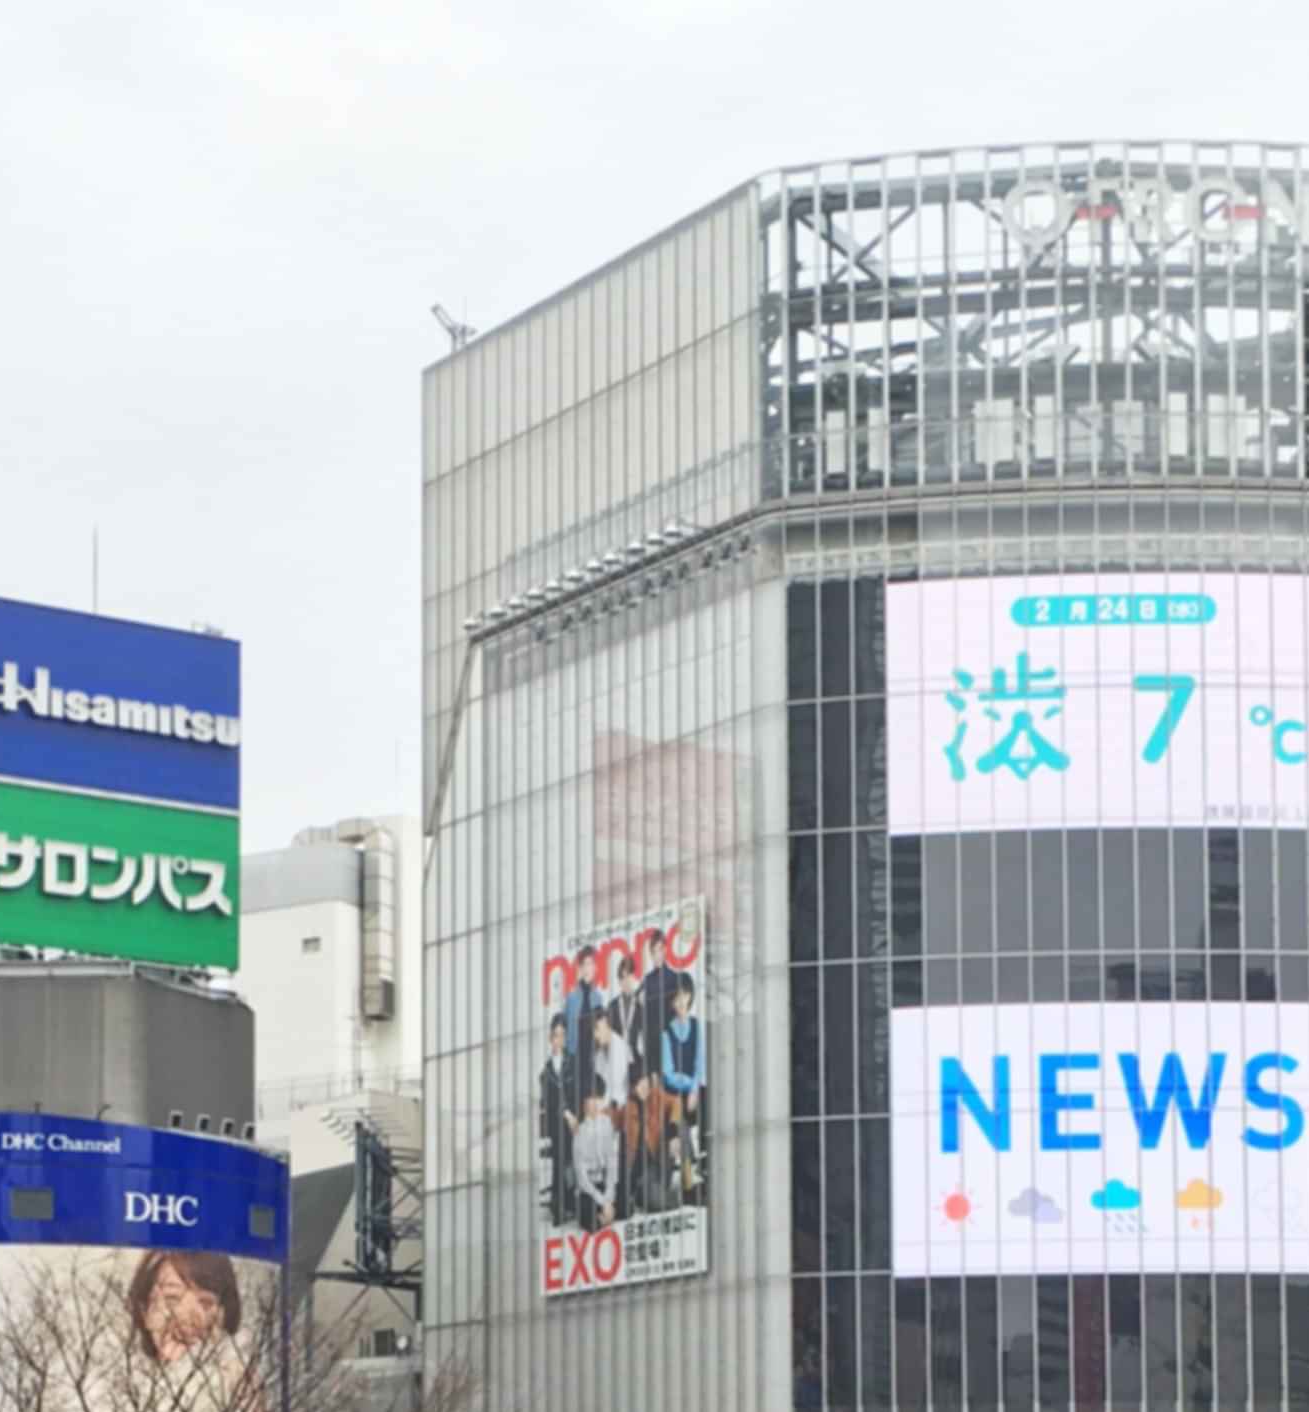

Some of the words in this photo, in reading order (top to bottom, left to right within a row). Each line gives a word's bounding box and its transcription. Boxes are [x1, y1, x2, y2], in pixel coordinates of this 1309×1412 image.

[943, 652, 1071, 781] 渋
[1131, 674, 1197, 764] 7
[940, 1051, 1306, 1154] NEWS
[1, 1132, 45, 1152] DHC
[47, 1133, 121, 1154] Channel
[125, 1192, 199, 1227] DHC
[544, 1227, 623, 1293] EXO
